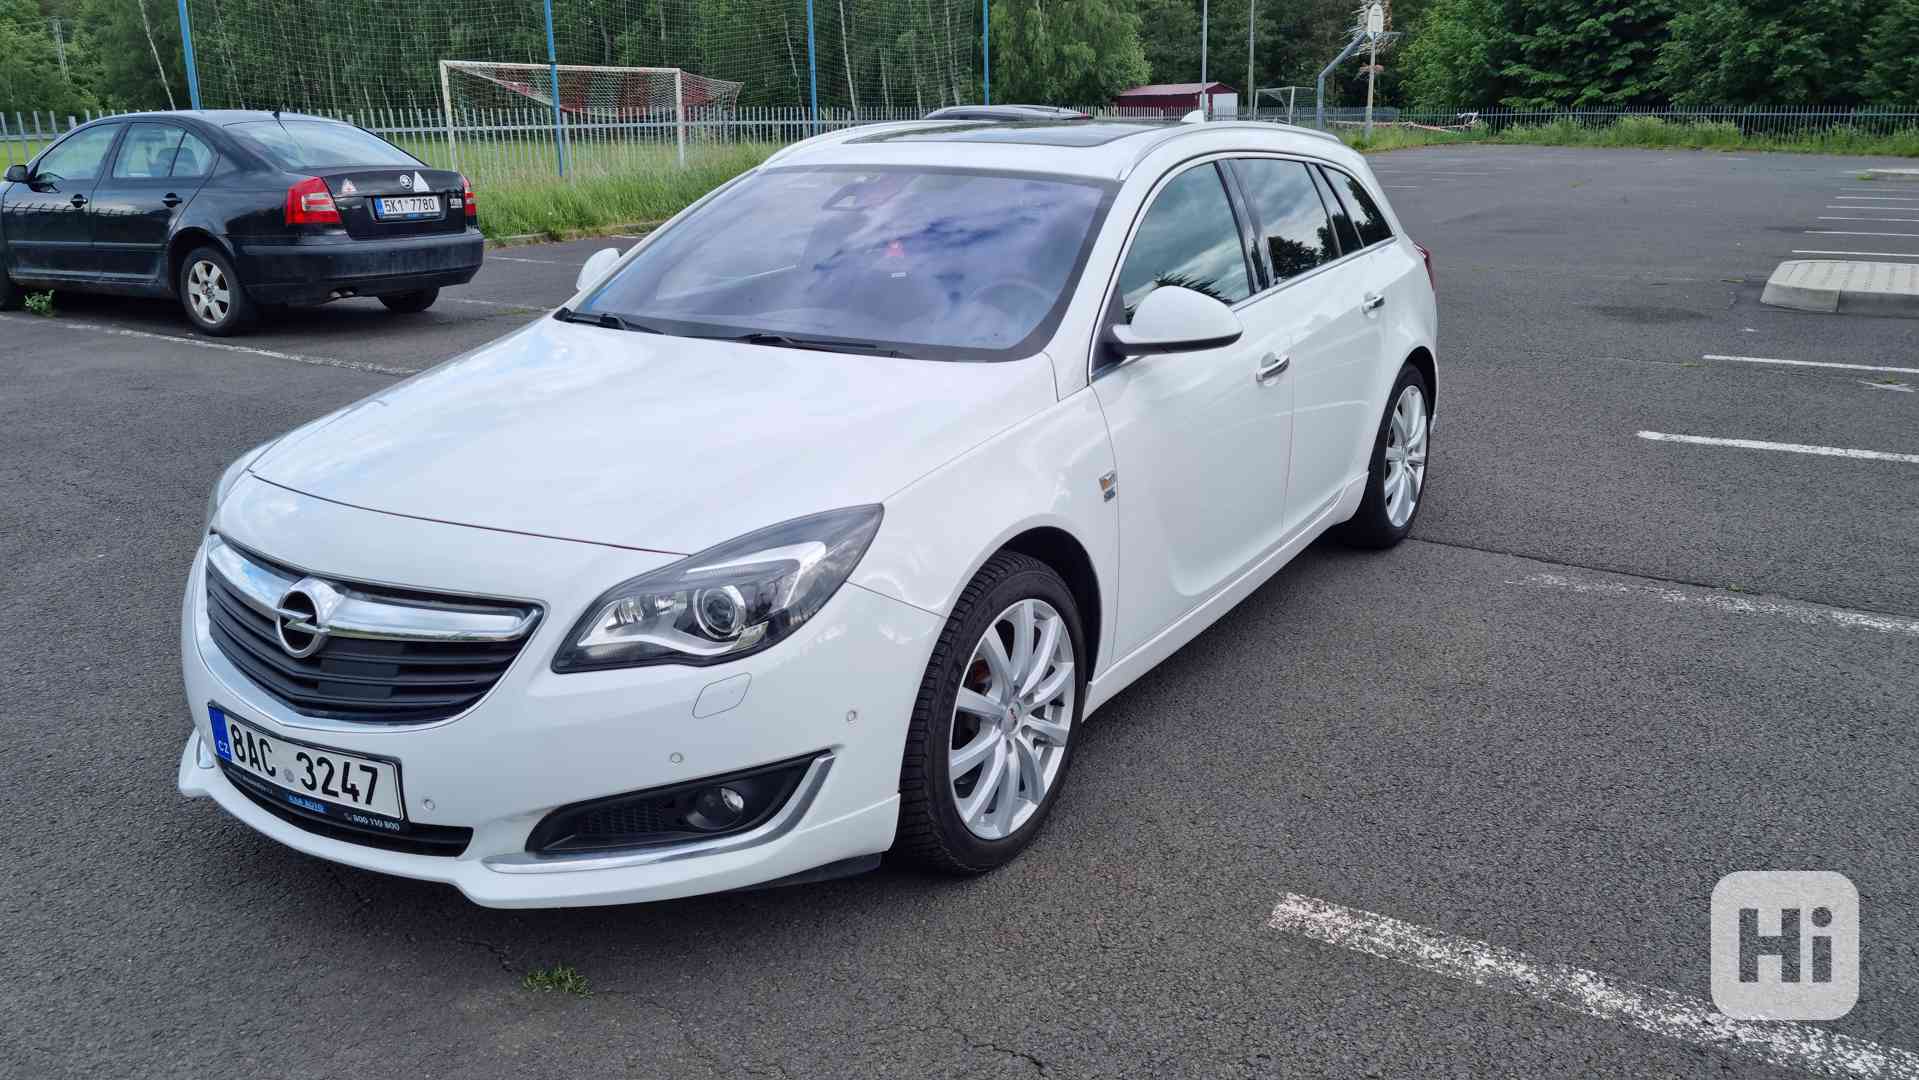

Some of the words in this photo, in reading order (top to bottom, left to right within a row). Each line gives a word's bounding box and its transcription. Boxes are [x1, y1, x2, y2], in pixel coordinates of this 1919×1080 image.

[384, 198, 403, 213] 5K1
[410, 198, 435, 211] 7780
[218, 740, 230, 754] CZ
[230, 723, 276, 777] 8AC
[296, 751, 378, 806] 3247
